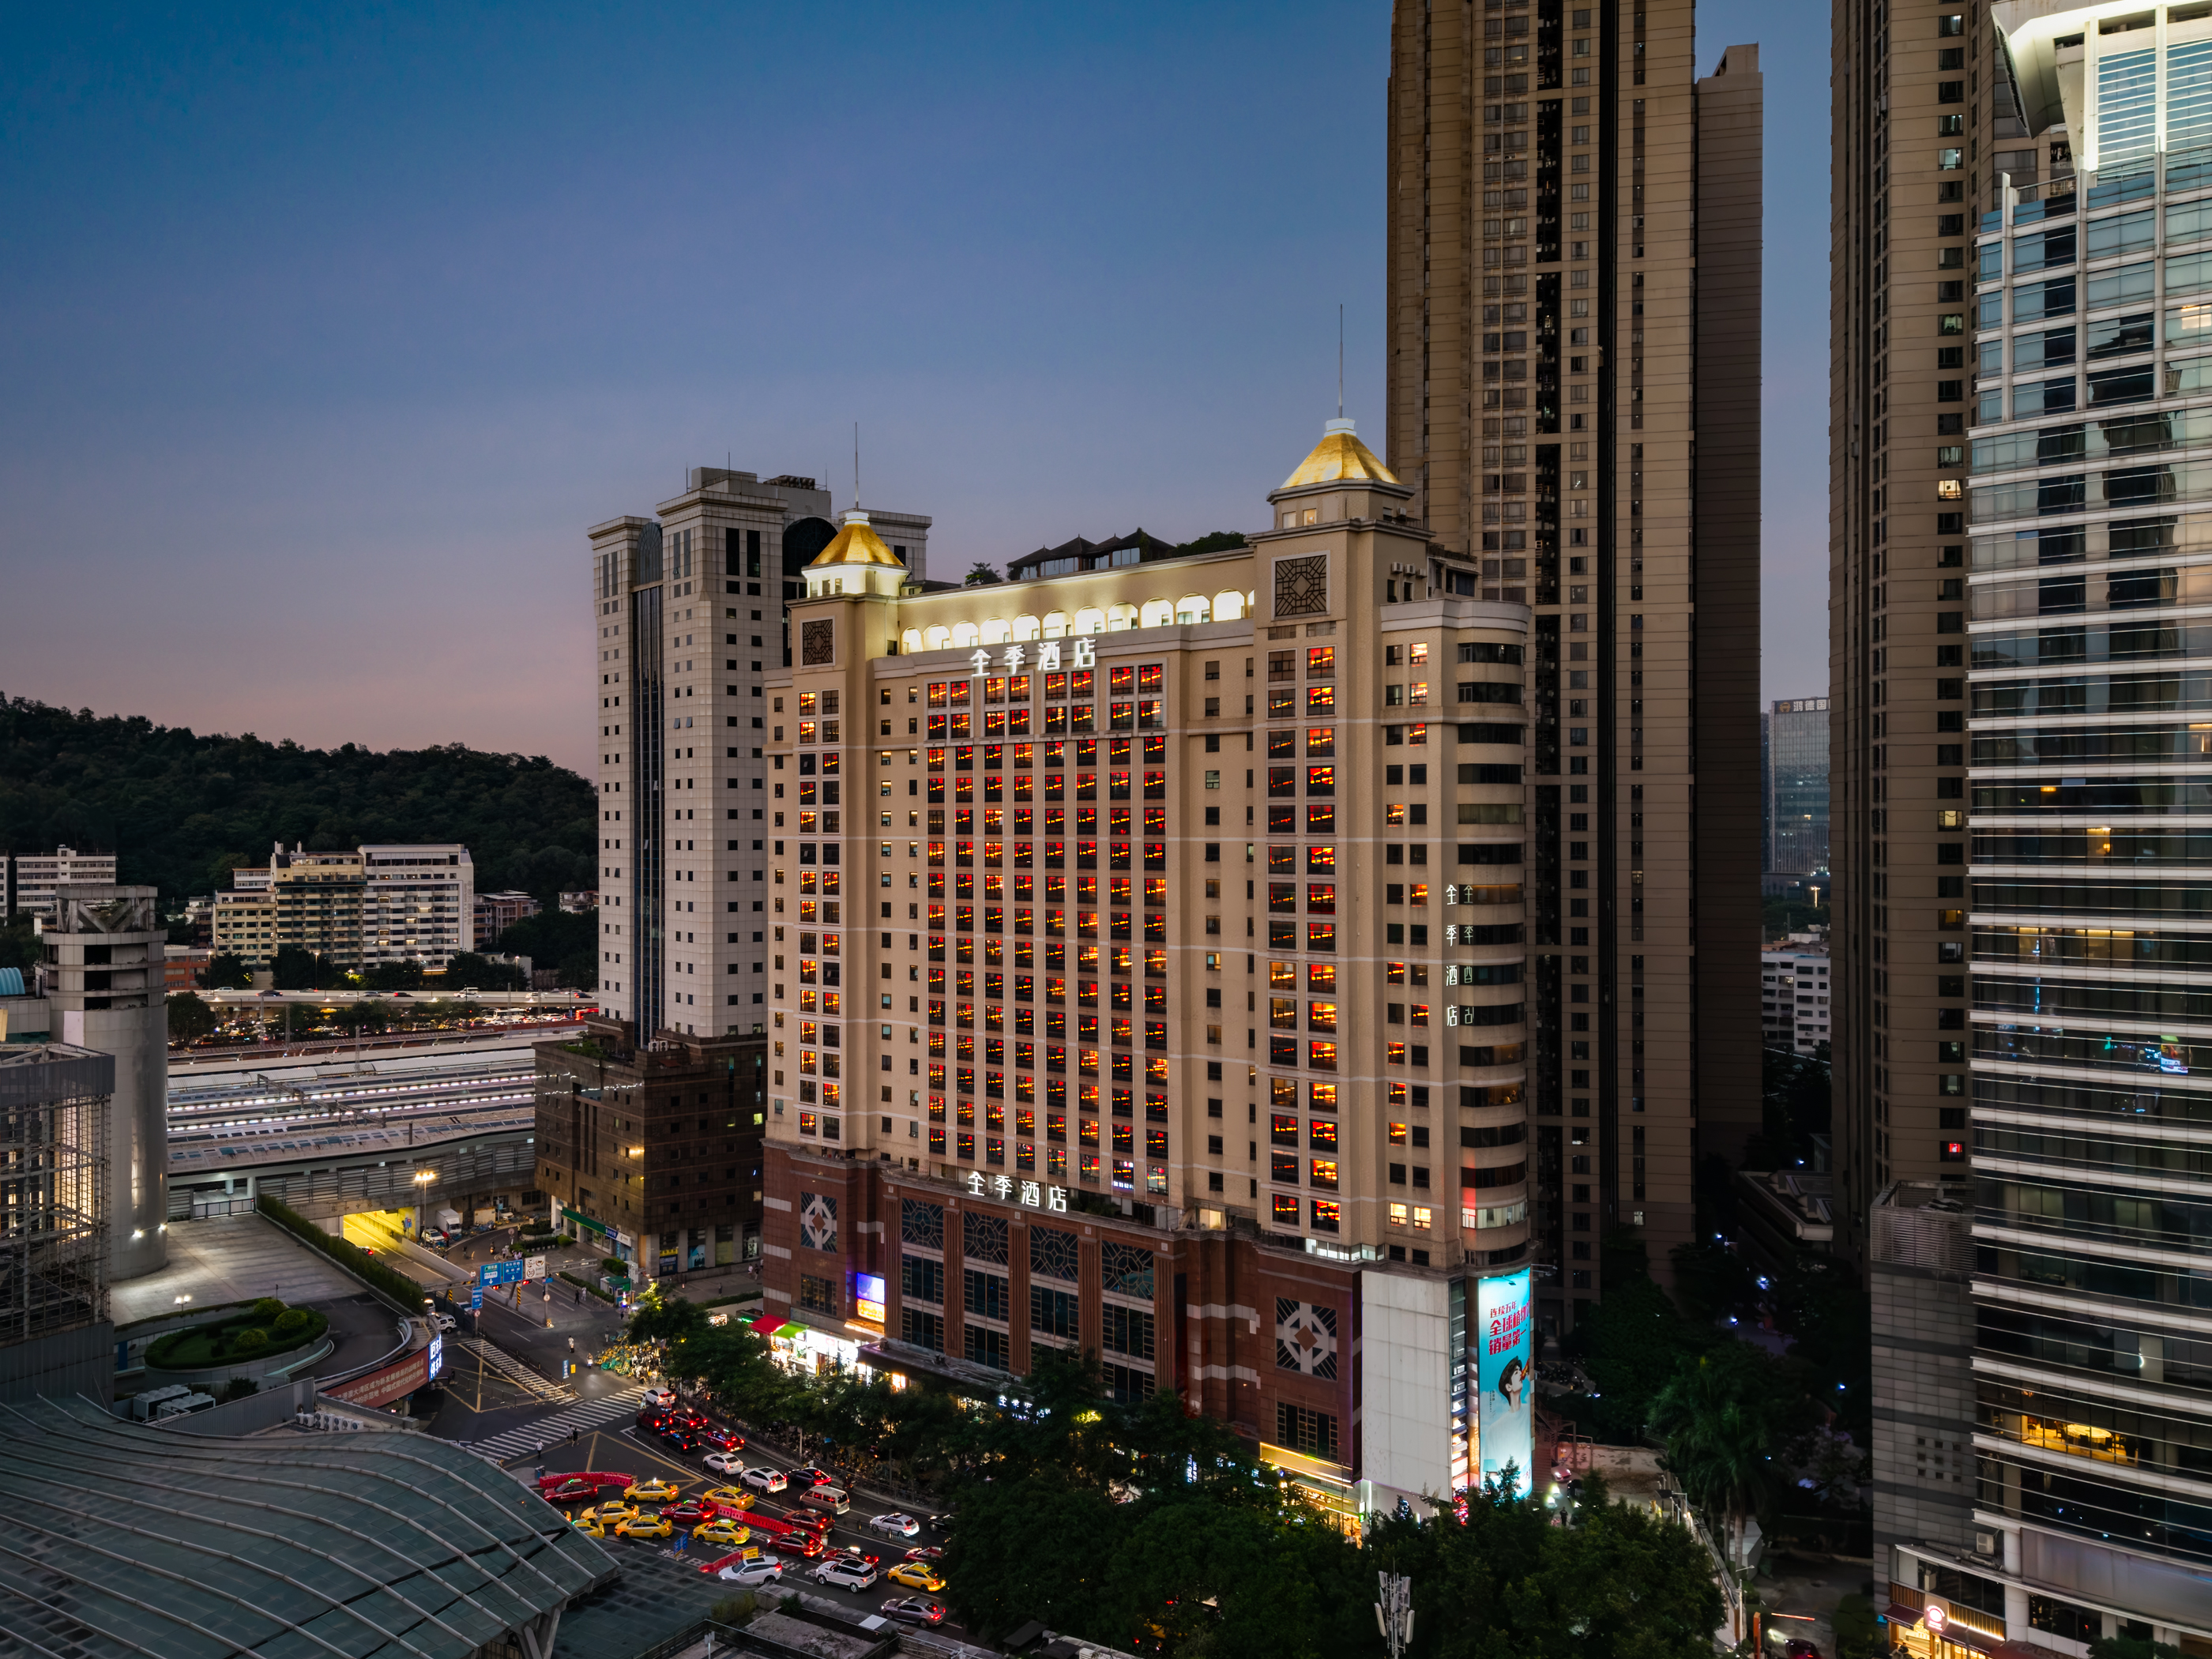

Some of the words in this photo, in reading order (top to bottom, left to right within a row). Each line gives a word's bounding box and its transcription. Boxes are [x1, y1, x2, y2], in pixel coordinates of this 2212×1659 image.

[970, 637, 1097, 677] 全季酒店
[1793, 699, 1830, 712] 鸿德国
[1446, 884, 1458, 1027] 全季酒店
[968, 1172, 1066, 1213] 全季酒店
[1490, 1300, 1517, 1319] 连续五年
[1489, 1329, 1526, 1356] 销量第一
